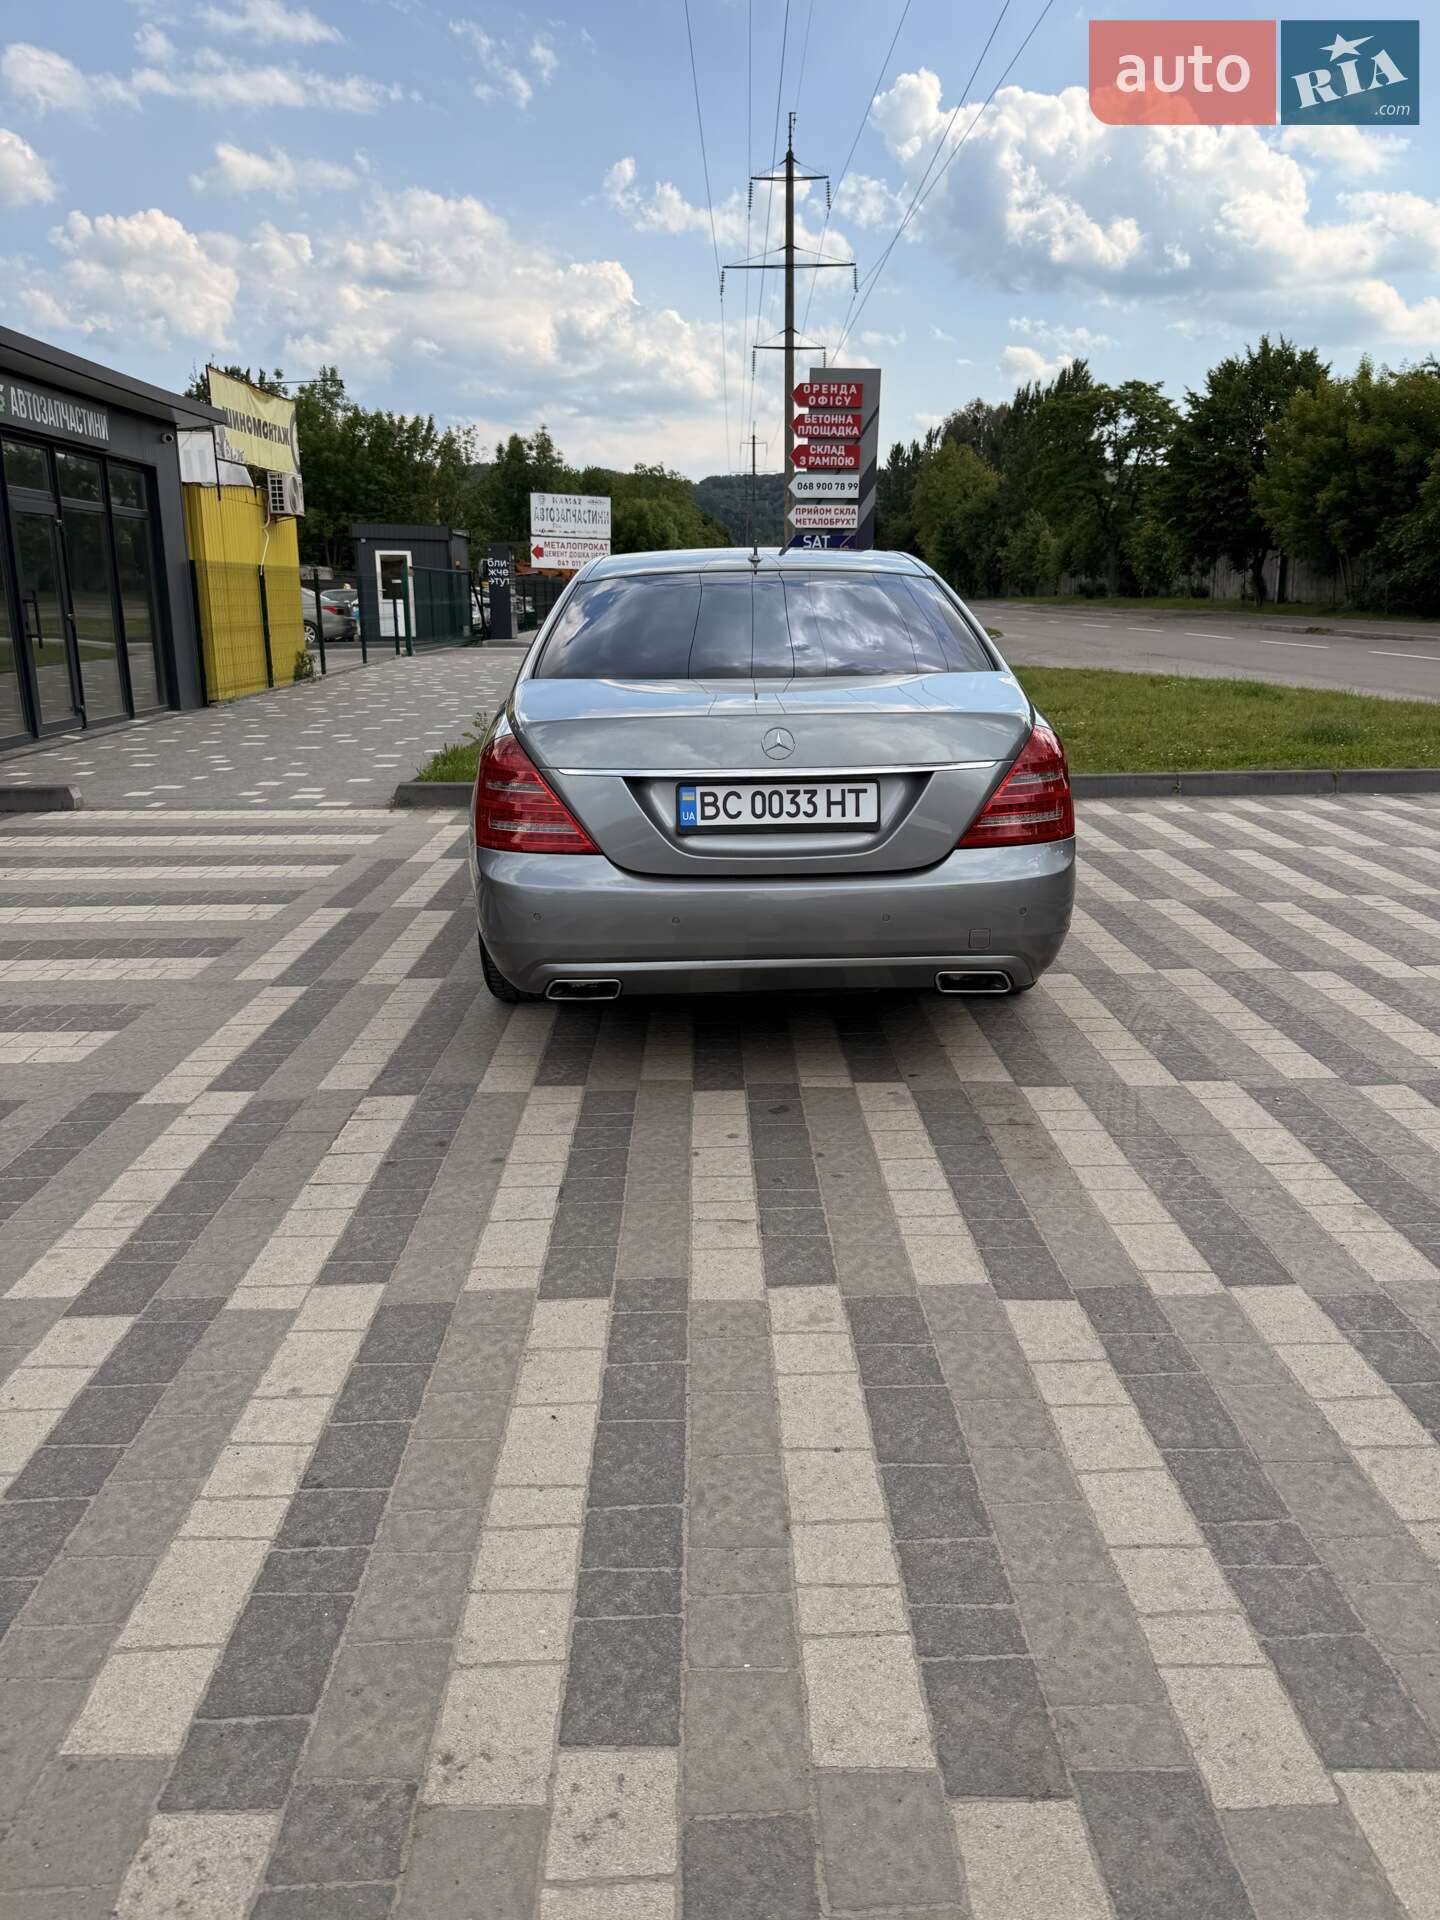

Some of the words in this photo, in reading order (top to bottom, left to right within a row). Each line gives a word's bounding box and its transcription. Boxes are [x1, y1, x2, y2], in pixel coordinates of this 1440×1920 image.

[803, 384, 857, 395] ОРЕНДА
[808, 396, 852, 406] ОФІСУ
[10, 386, 109, 441] АВТОЗАПЧАСТИНИ
[804, 414, 853, 424] БЕТОННА
[797, 426, 860, 437] ПЛОЩАДКА
[809, 445, 846, 456] СКЛАД
[799, 456, 806, 466] З
[808, 456, 855, 466] РАМПОЮ
[797, 482, 814, 491] 068
[816, 482, 833, 491] 900
[835, 482, 846, 491] 78
[847, 482, 859, 491] 99
[534, 506, 609, 525] АВТОЗАПЧАСТИНИ
[795, 507, 832, 516] ПРИЙОМ
[833, 507, 857, 516] СКЛА
[795, 518, 857, 526] МЕТАЛОБРУХТ
[544, 541, 609, 551] МЕТАЛОПРОКАТ
[802, 535, 831, 549] SAT
[544, 550, 567, 558] ЦЕМЕНТ
[569, 551, 590, 559] ДОШКА
[488, 568, 509, 577] жче
[700, 790, 743, 820] BC
[750, 789, 818, 819] 0033
[826, 788, 868, 818] HT
[682, 812, 696, 821] UA
